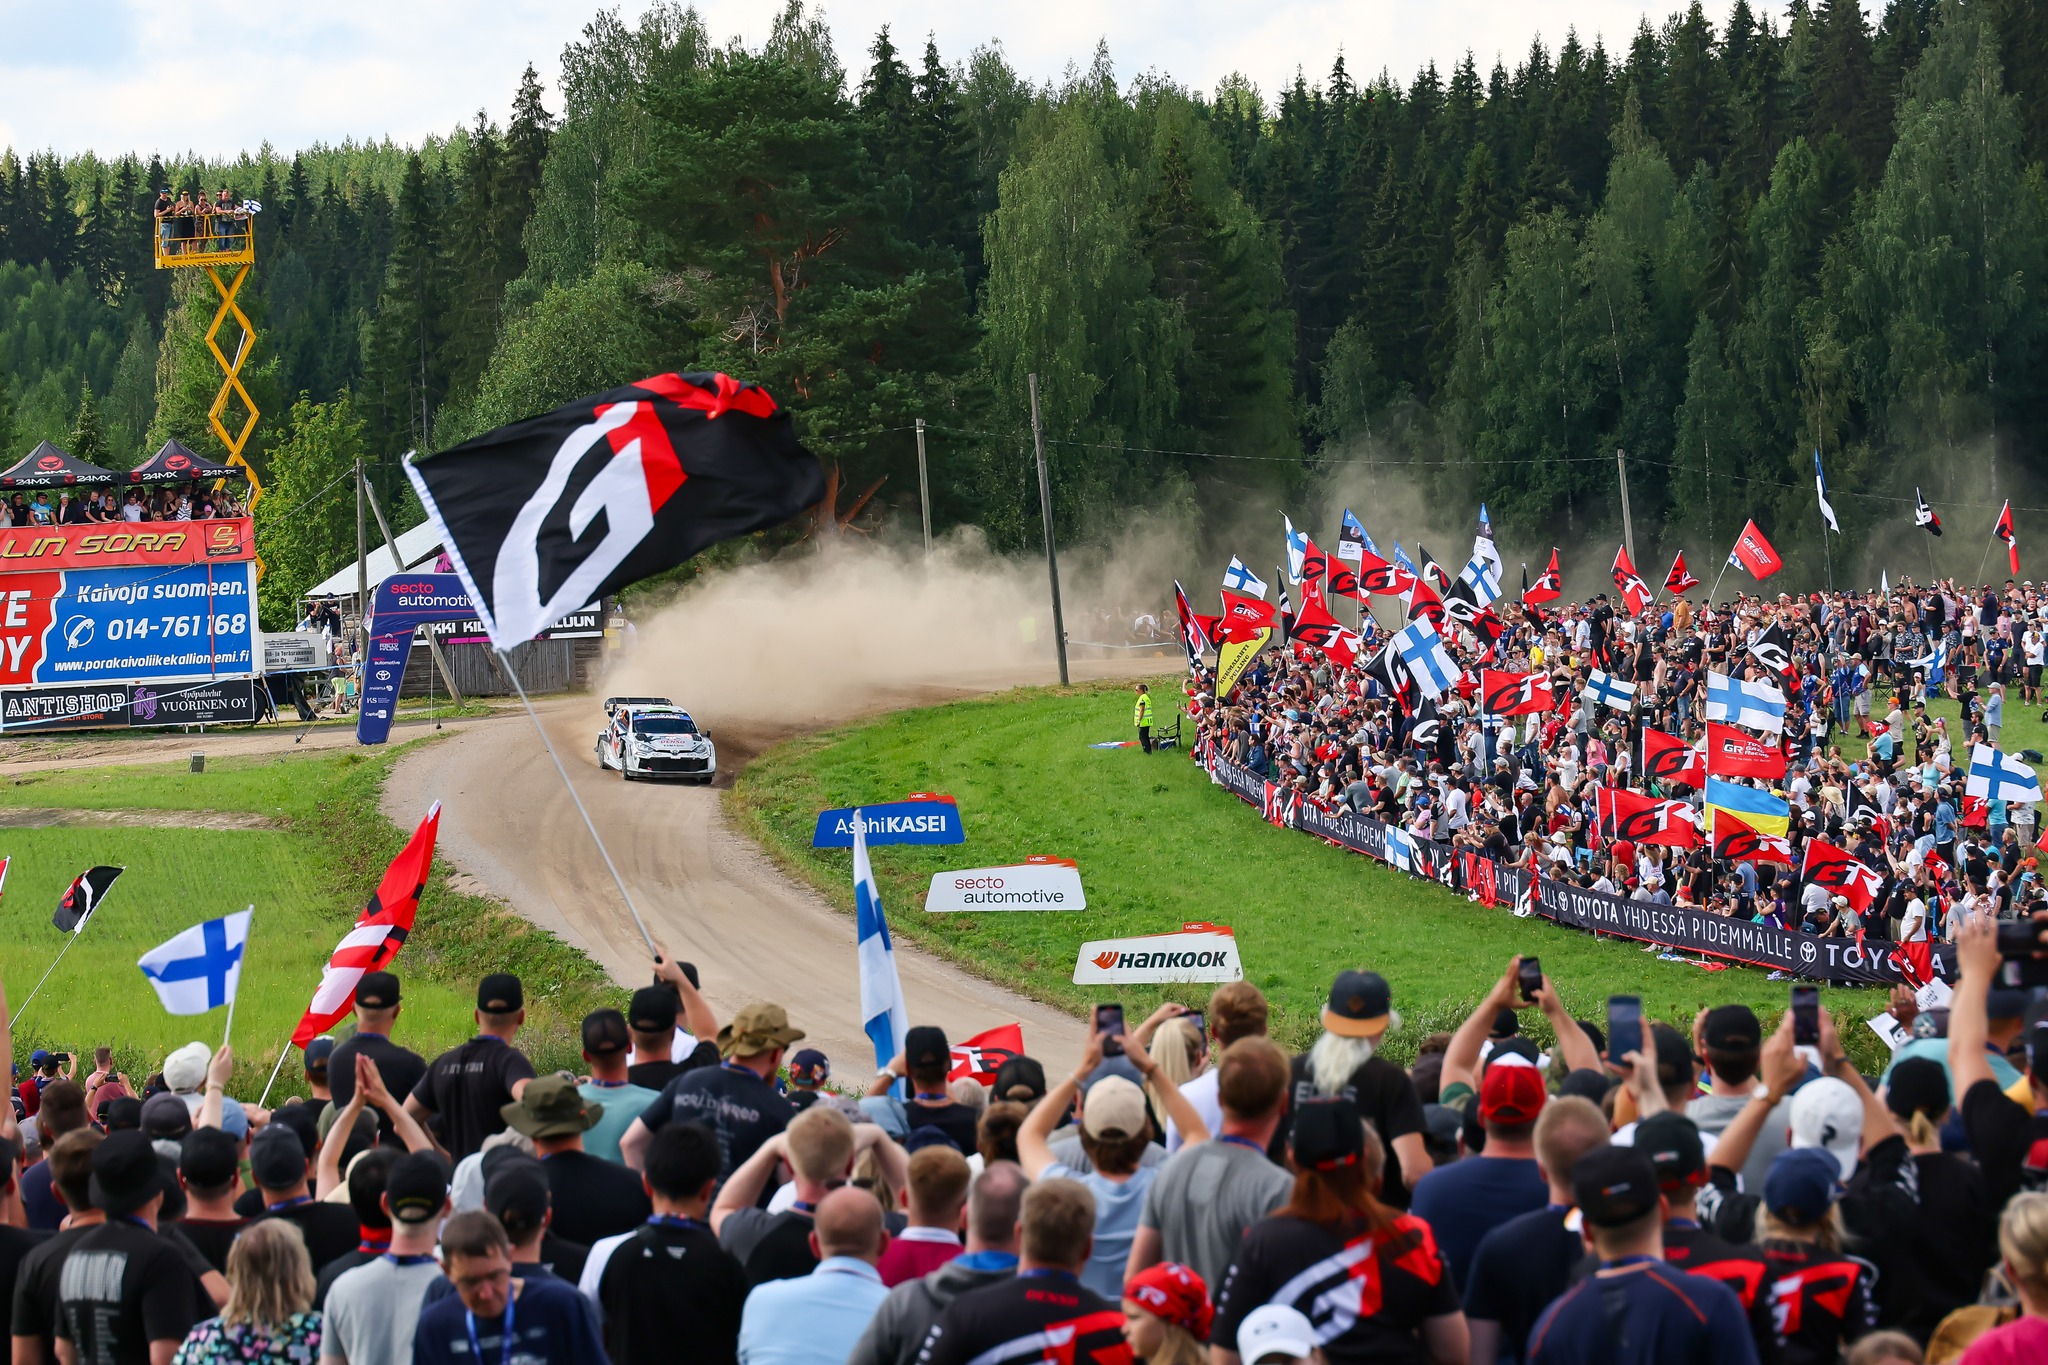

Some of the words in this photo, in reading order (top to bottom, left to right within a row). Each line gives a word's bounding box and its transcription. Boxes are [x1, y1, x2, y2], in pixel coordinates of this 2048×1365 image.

[16, 478, 51, 486] 24MX
[143, 471, 177, 480] 24MX
[202, 469, 238, 477] 24MX
[0, 536, 67, 558] LIN
[75, 532, 187, 555] SORA
[77, 582, 148, 605] Kaivoja
[152, 581, 247, 599] suomeen.
[391, 582, 434, 594] secto
[0, 590, 31, 627] E
[398, 595, 474, 606] automotiv
[107, 615, 200, 641] 014-761
[206, 613, 247, 637] 168
[0, 635, 32, 673] Y
[54, 650, 250, 672] www.porakaivoliikekallioniemi.fi
[1229, 654, 1251, 681] PULLING
[6, 693, 126, 717] ANTISHOP
[161, 699, 228, 712] VUORINEN
[231, 698, 248, 709] OY
[1303, 802, 1318, 825] OTA
[955, 876, 1004, 889] secto
[964, 889, 1064, 904] automotive
[1571, 893, 1618, 924] TOYOTA
[1622, 904, 1686, 937] YHDESSÄ
[1692, 917, 1792, 960] PIDEMMÄLLE
[1826, 943, 1946, 975] TOYA
